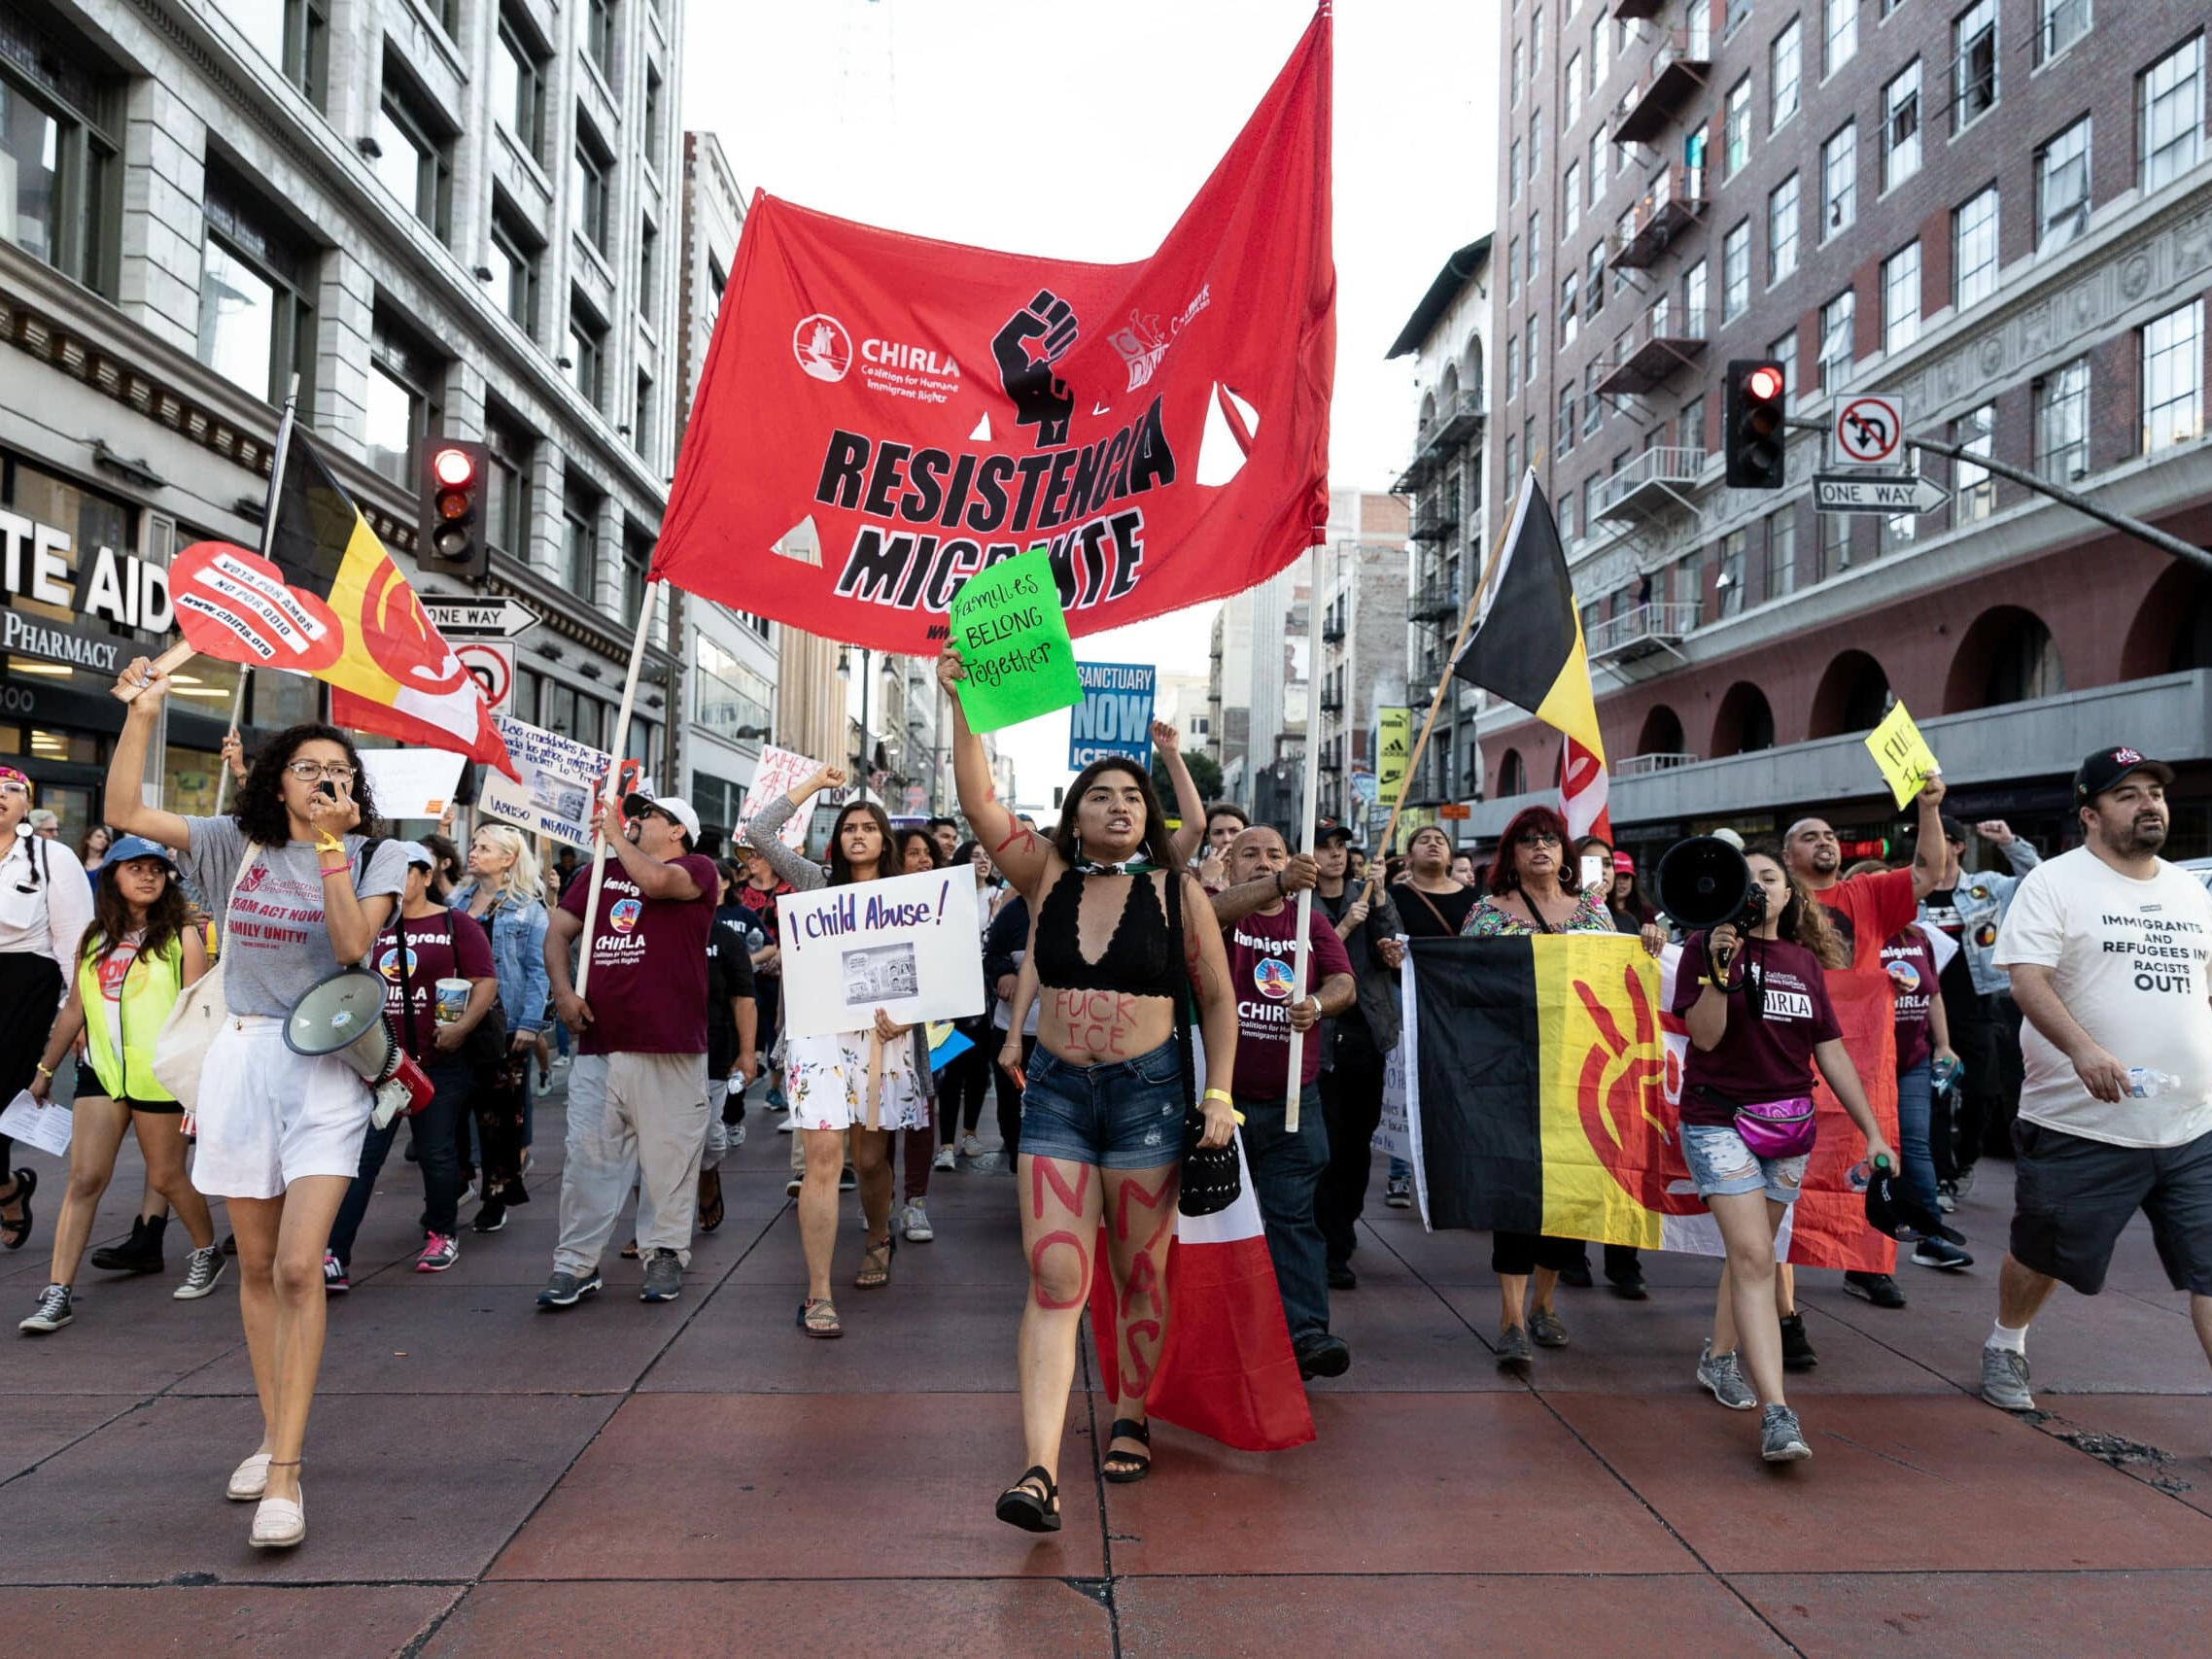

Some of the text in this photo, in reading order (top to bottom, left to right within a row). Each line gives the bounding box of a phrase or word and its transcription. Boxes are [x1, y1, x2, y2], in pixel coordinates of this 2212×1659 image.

[861, 338, 960, 377] CHIRLA
[861, 364, 958, 393] Coalition for Humane
[867, 378, 916, 398] Immigrant
[814, 393, 1176, 534] RESISTENCIA
[1823, 485, 1916, 502] ONE WAY
[834, 508, 1144, 613] MIGNTE
[85, 546, 174, 633] AID
[215, 580, 236, 596] NO
[262, 606, 291, 637] ODIO
[282, 599, 314, 633] AMOR
[428, 608, 501, 624] ONE WAY
[3, 611, 118, 670] PHARMACY
[183, 595, 272, 656] www.chirla.org
[965, 606, 1043, 650] BELONG
[960, 642, 1051, 687] Together
[1077, 666, 1153, 691] SANCTUARY
[1074, 693, 1152, 743] NOW
[259, 905, 288, 919] ACT
[289, 909, 326, 922] NOW!
[2102, 915, 2202, 933] IMMIGRANTS
[264, 923, 308, 944] UNITY!
[2103, 941, 2189, 958] REFUGEES
[2145, 933, 2172, 944] AND
[2134, 960, 2190, 974] RACISTS
[2134, 974, 2191, 994] OUT!
[1055, 991, 1138, 1026] FUCK
[1065, 1023, 1125, 1055] ICE
